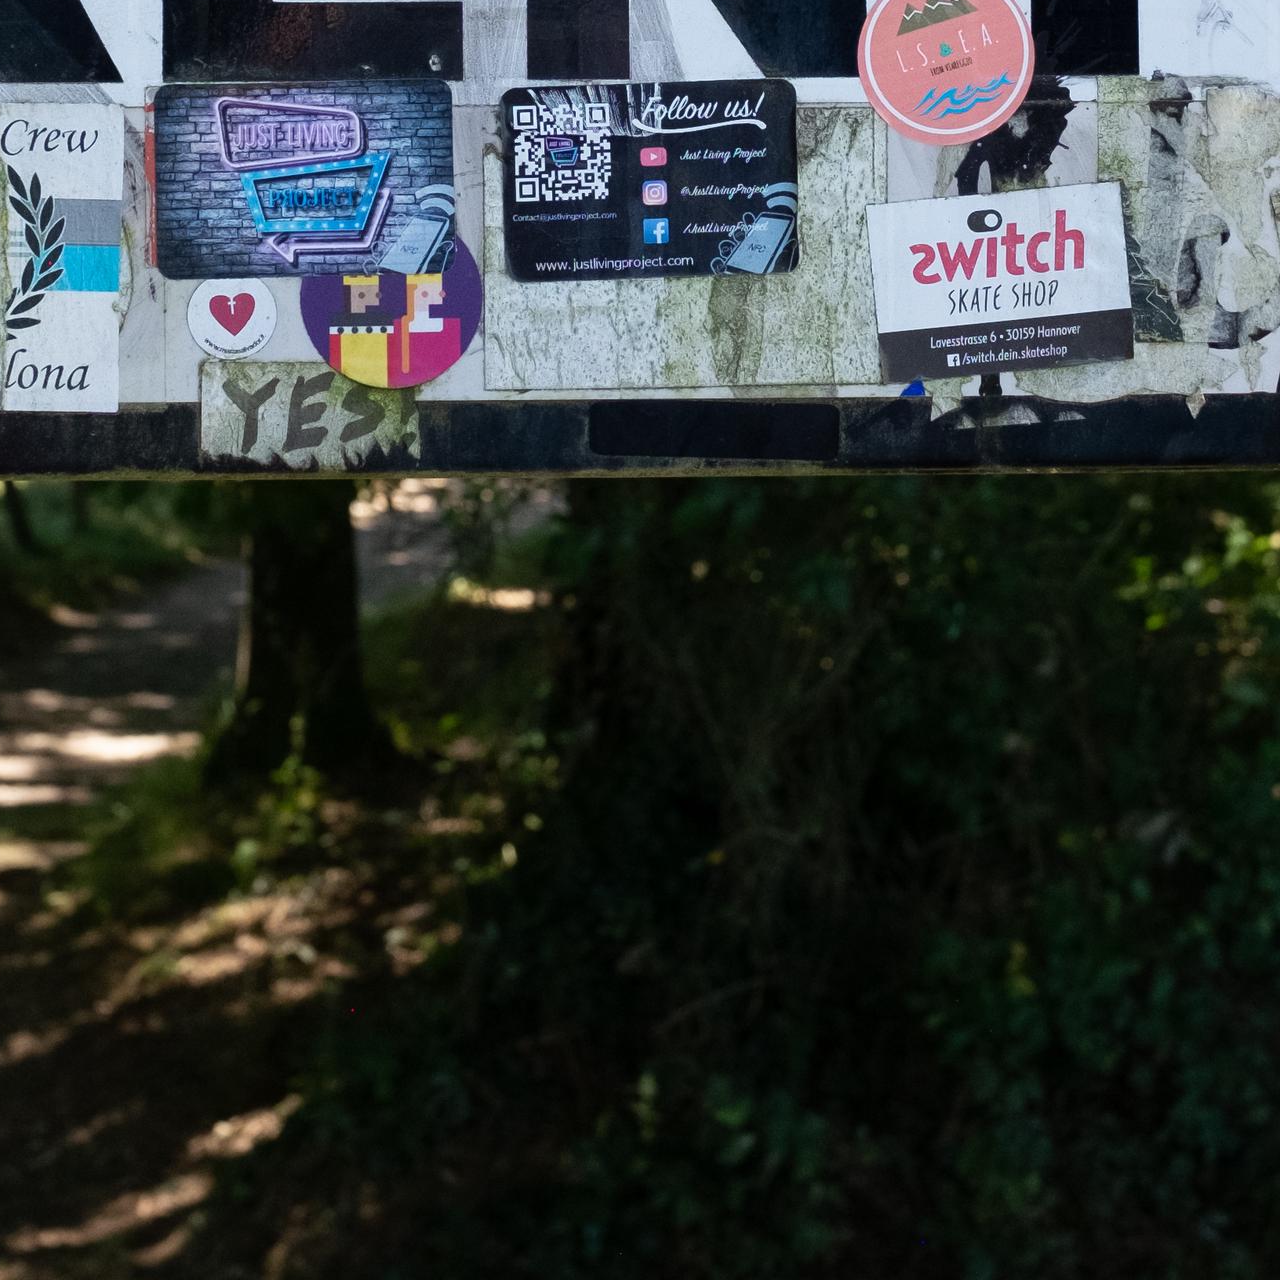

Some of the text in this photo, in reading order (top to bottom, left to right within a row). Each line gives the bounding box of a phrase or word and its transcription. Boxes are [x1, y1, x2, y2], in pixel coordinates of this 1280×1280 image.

[642, 92, 766, 121] Follow us!
[0, 118, 99, 156] Crew
[232, 121, 353, 150] JUST LIVING
[679, 147, 768, 163] Just Living Project
[948, 279, 1060, 316] SKATE SHOP
[930, 323, 1082, 350] Lavesstrasse 6 30159 Hannover
[962, 344, 1068, 366] /switch.dein.skateshop
